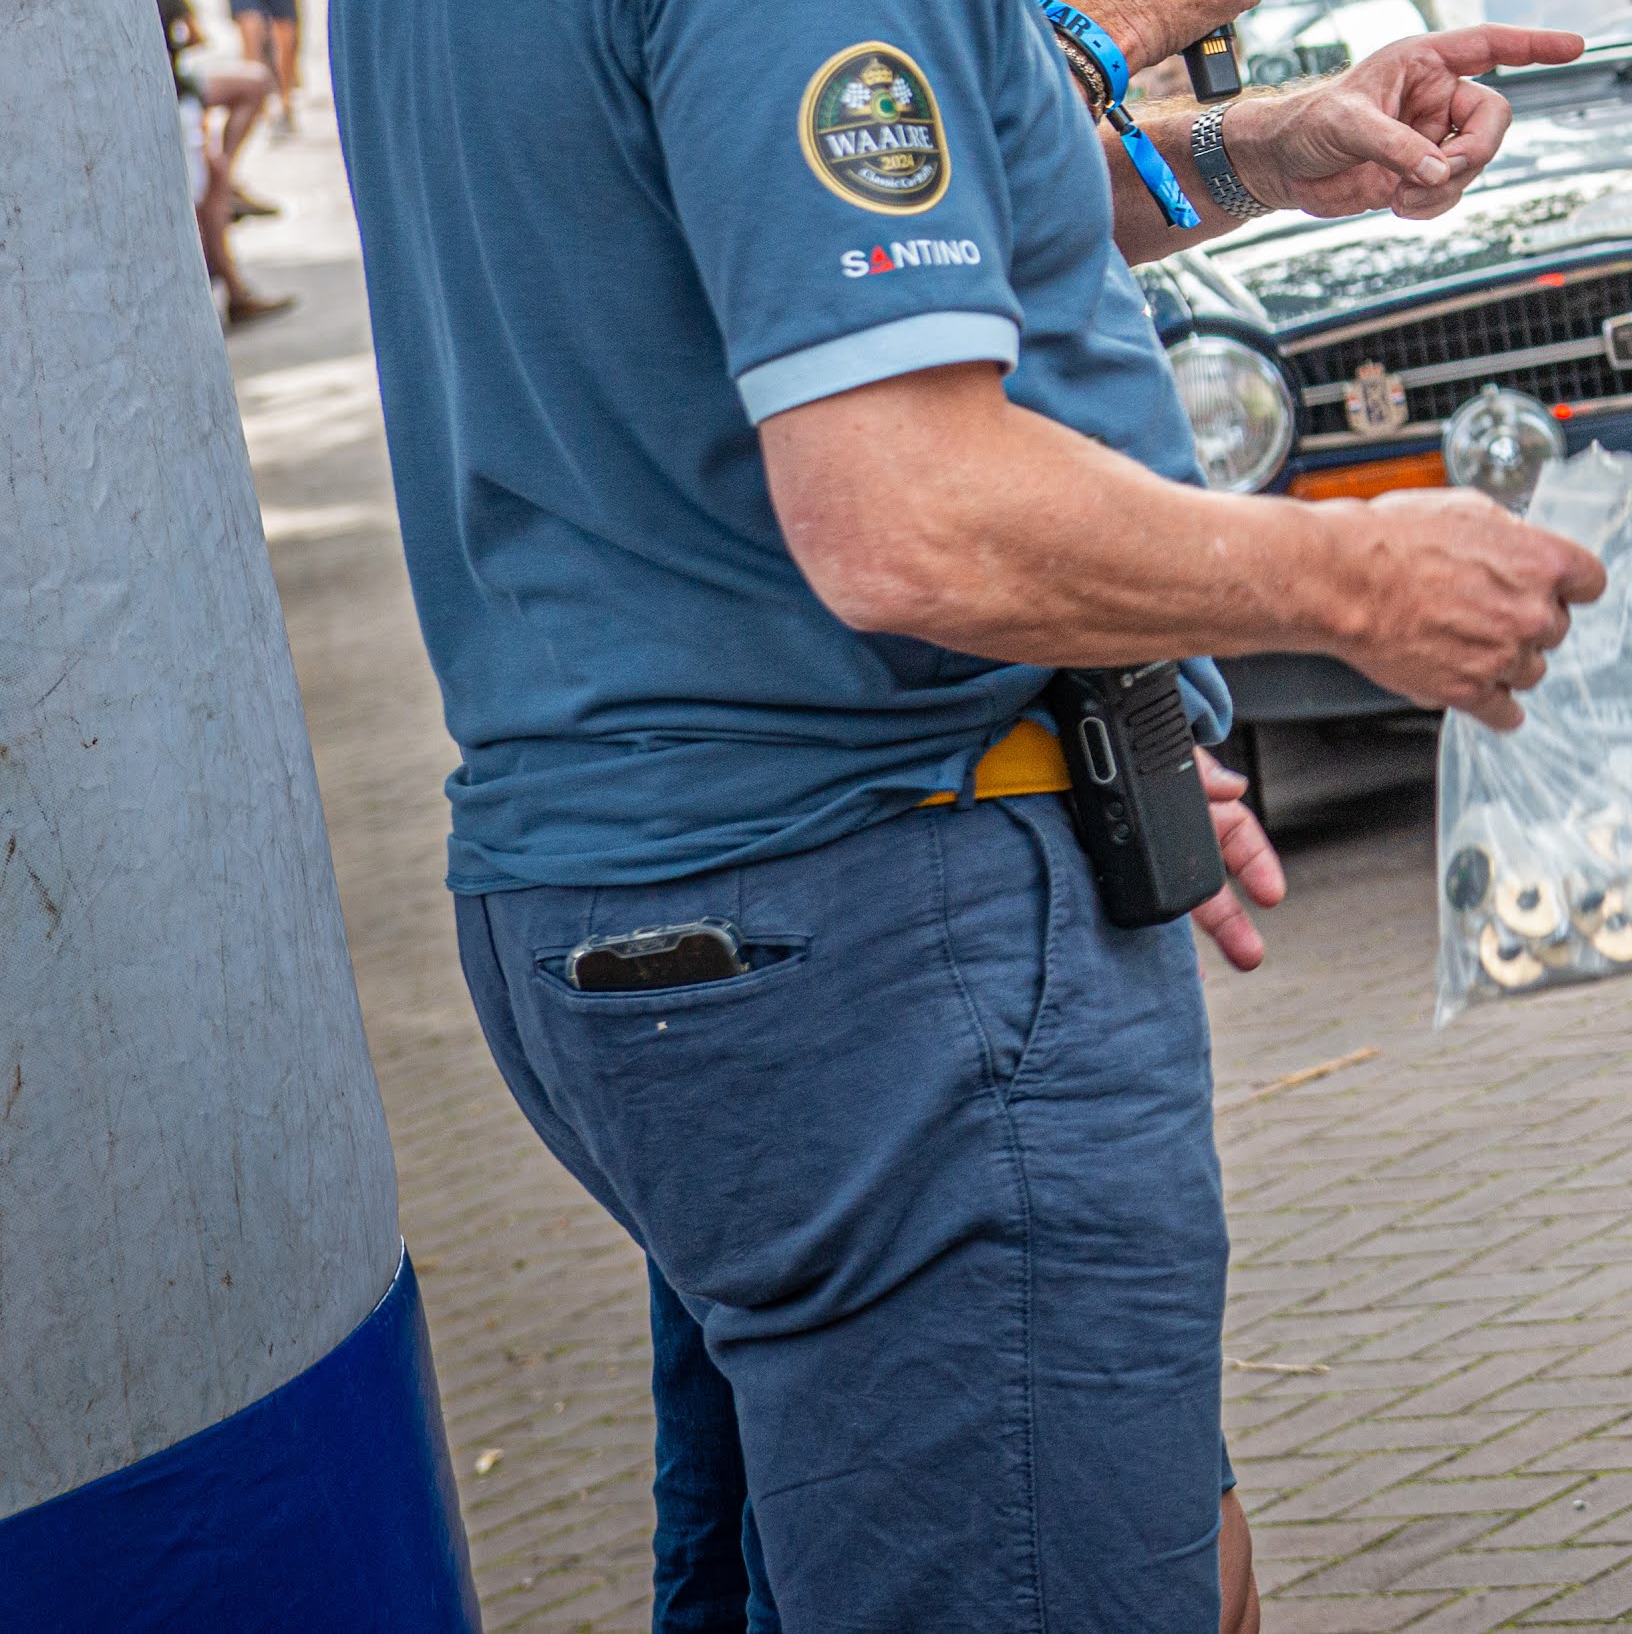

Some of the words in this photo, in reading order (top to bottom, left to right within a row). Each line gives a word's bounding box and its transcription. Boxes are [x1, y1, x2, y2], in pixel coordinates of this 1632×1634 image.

[825, 124, 934, 159] WAALRE
[877, 153, 916, 171] 2024
[839, 238, 982, 279] SANTINO
